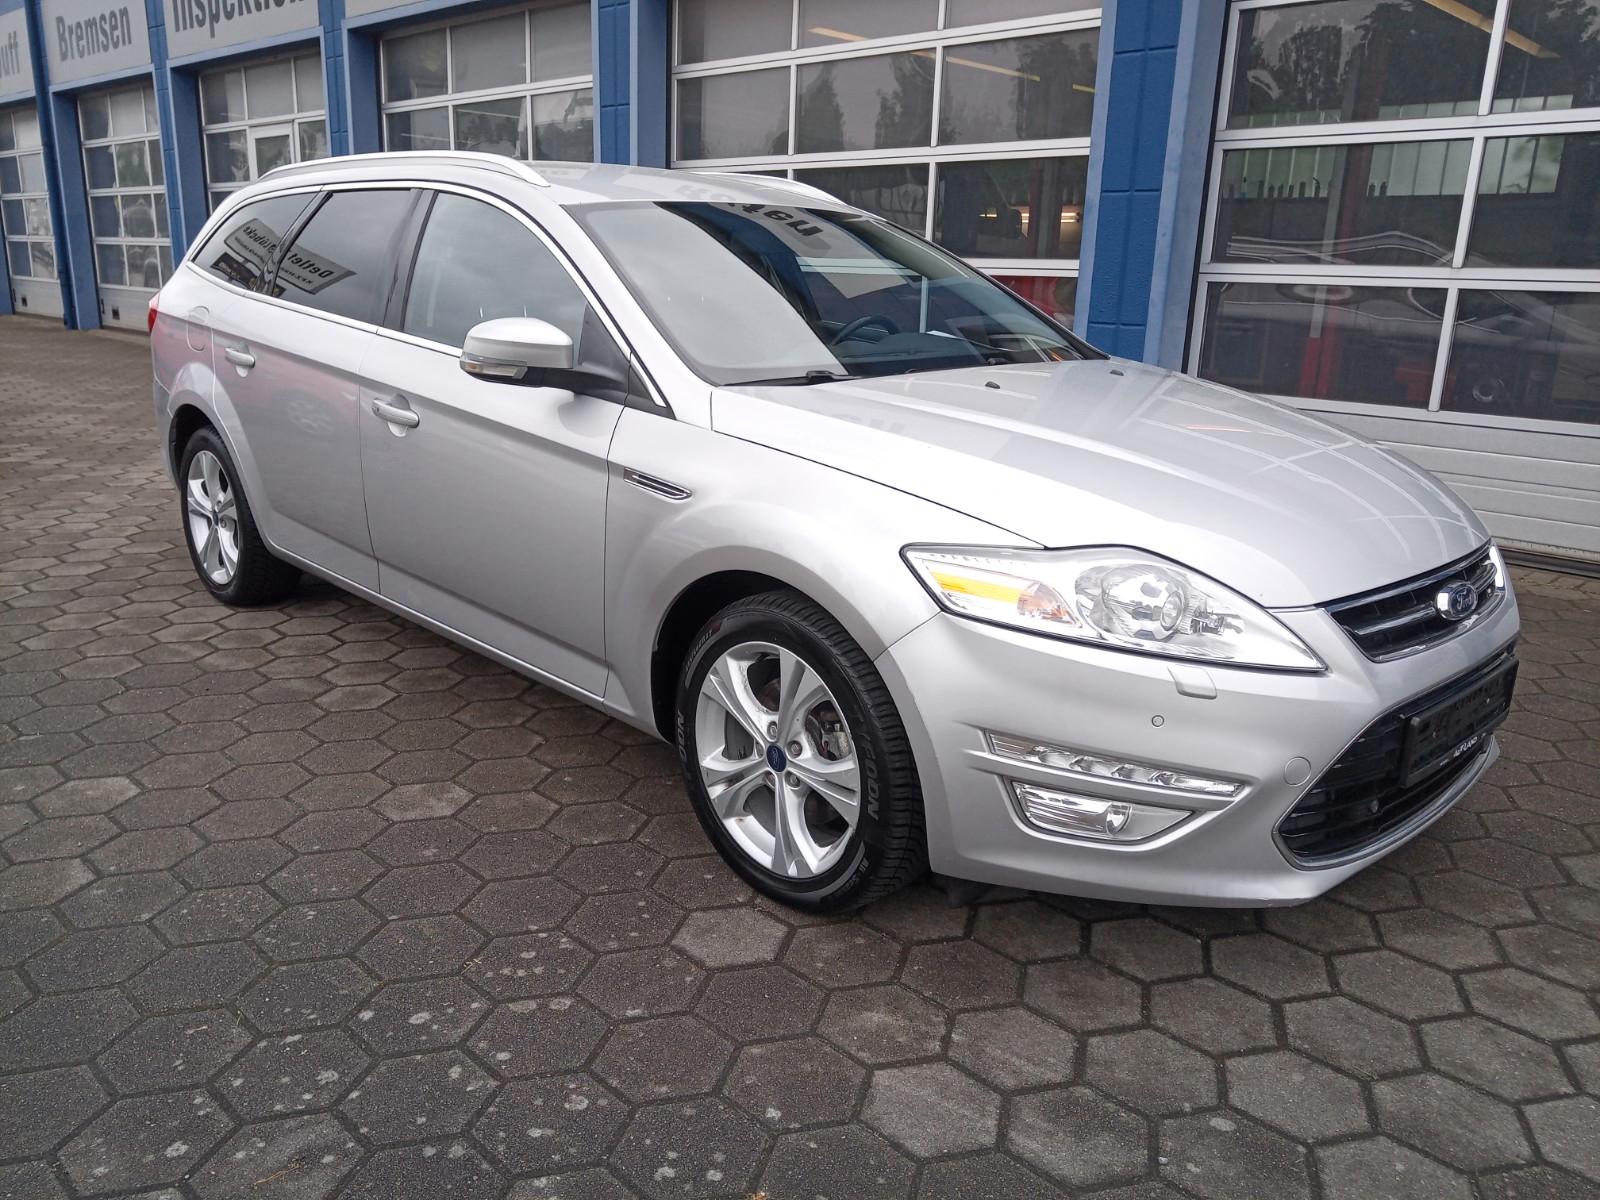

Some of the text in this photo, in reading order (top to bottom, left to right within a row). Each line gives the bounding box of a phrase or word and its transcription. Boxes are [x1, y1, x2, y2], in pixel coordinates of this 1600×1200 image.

[56, 7, 132, 62] Bremsen
[173, 0, 303, 38] Inspe
[0, 31, 20, 77] uff
